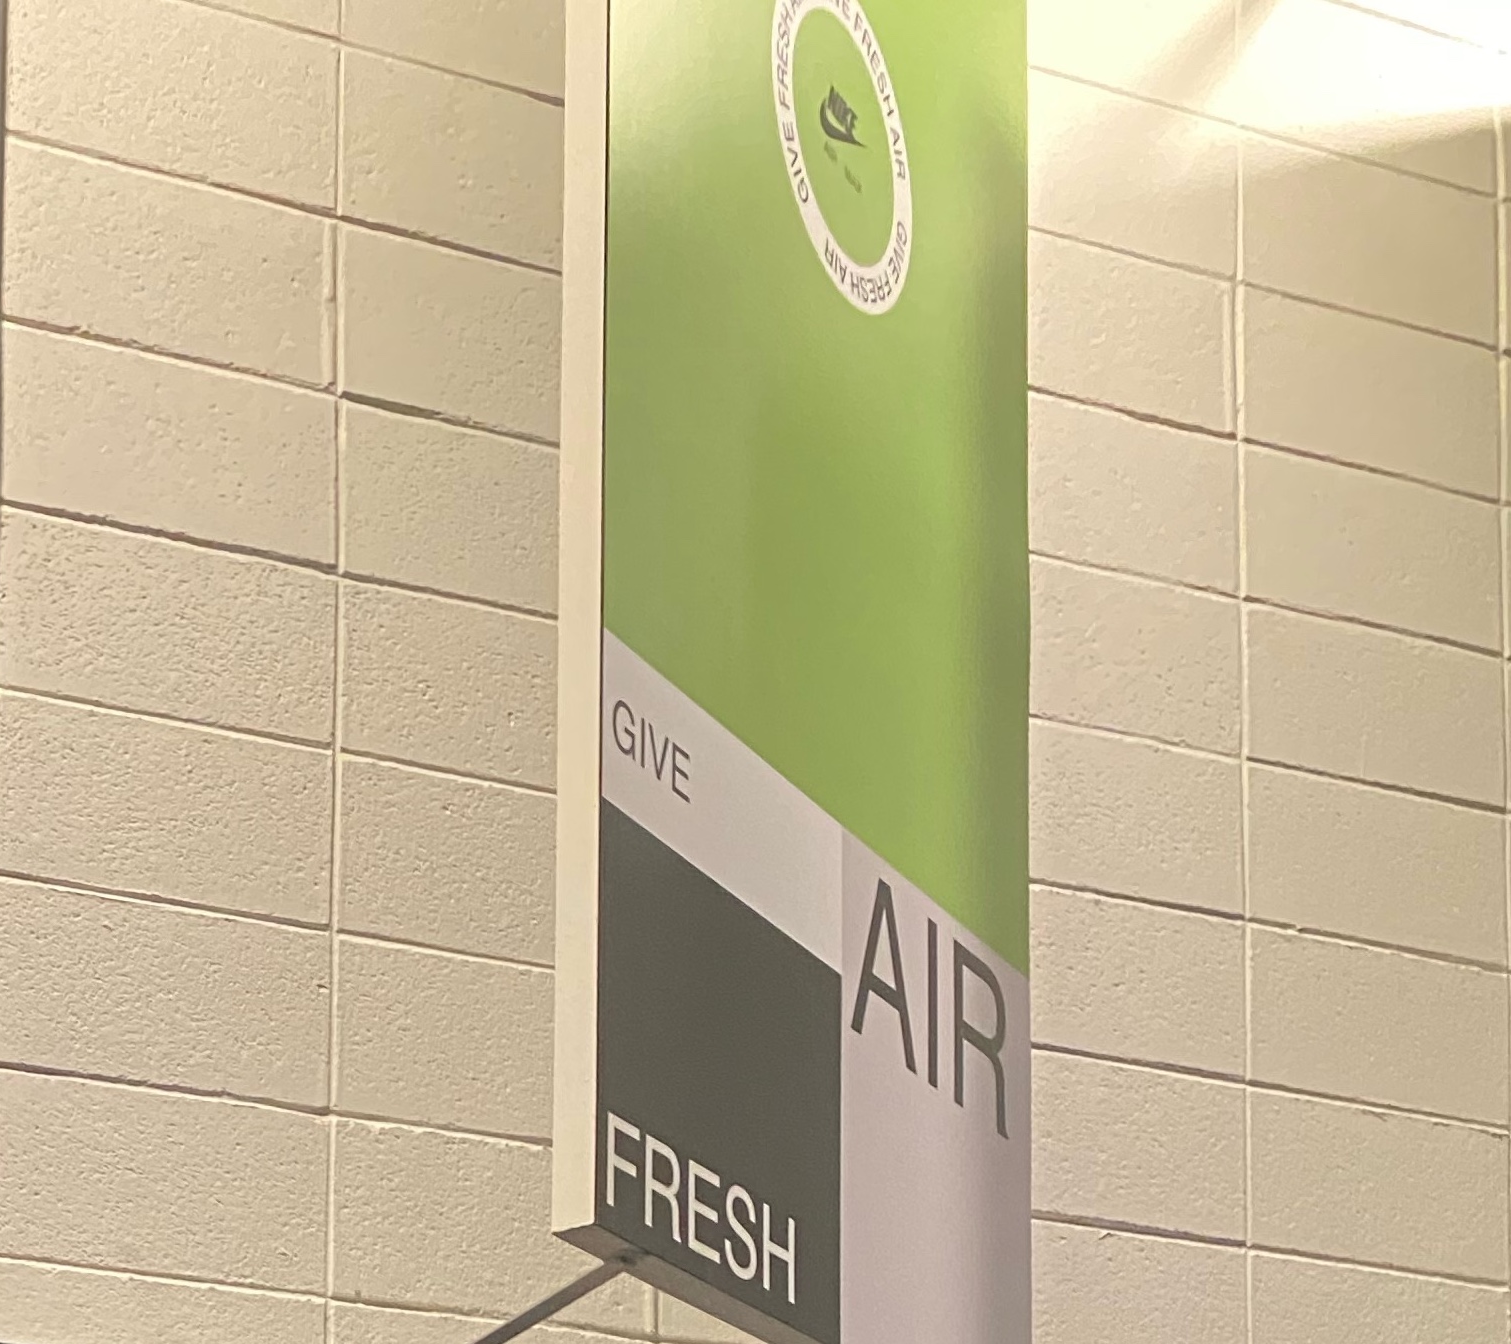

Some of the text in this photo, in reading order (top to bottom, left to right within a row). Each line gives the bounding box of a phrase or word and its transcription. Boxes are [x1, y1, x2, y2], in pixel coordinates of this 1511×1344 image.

[776, 2, 809, 203] GIVE FRESH
[854, 12, 906, 181] FRESH AIR
[824, 221, 908, 303] GIVE FRESH AIR
[612, 699, 691, 804] GIVE
[850, 877, 1009, 1139] AIR
[605, 1110, 796, 1305] FRESH
